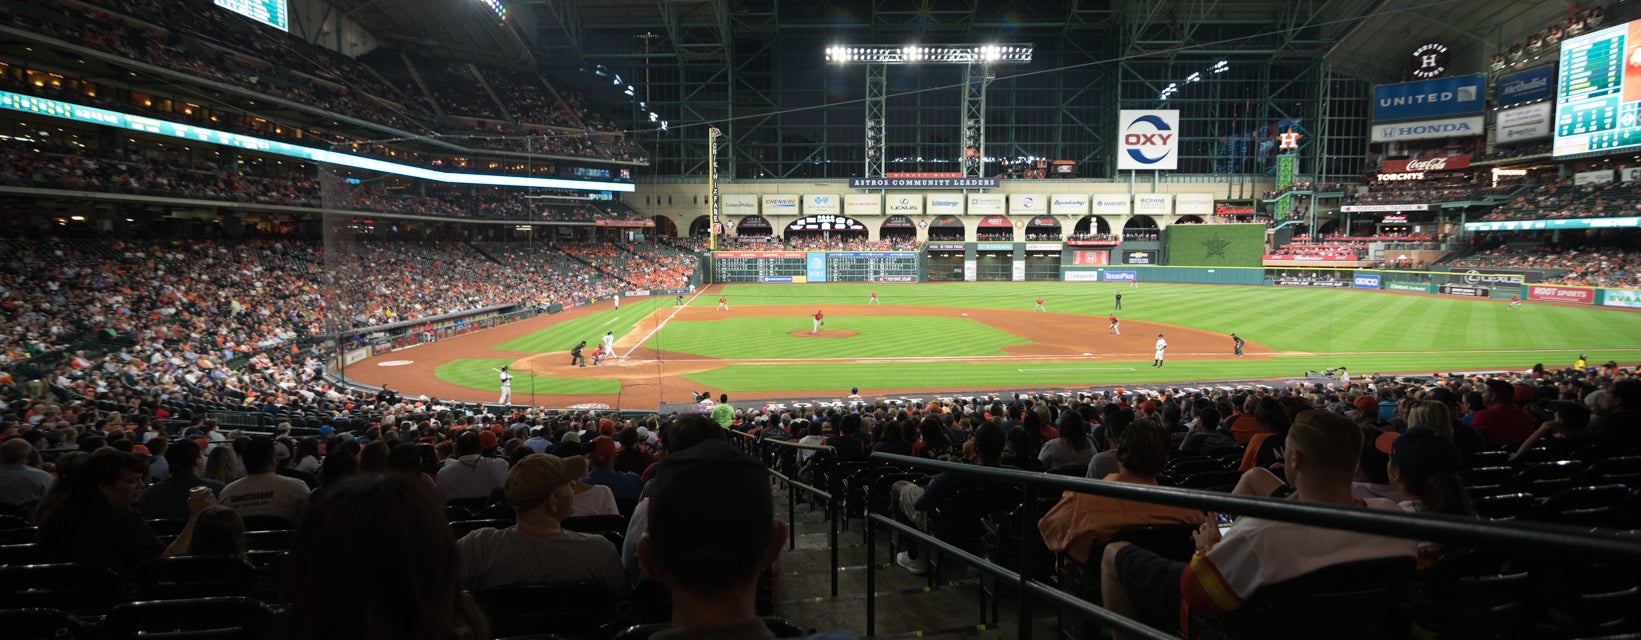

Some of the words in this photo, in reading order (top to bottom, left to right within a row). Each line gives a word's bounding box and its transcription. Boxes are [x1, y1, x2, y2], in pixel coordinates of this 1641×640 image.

[1412, 43, 1448, 57] HOUSTON
[1421, 54, 1437, 68] H
[1380, 91, 1453, 108] UNITED
[1398, 122, 1472, 136] HONDA
[1125, 134, 1172, 146] OXY
[1279, 133, 1299, 149] H
[1377, 172, 1424, 182] TORCHYS
[1354, 278, 1378, 286] GEICO
[1533, 287, 1555, 296] ROOT
[1557, 289, 1586, 298] SPORTS
[1609, 294, 1631, 303] EVA
